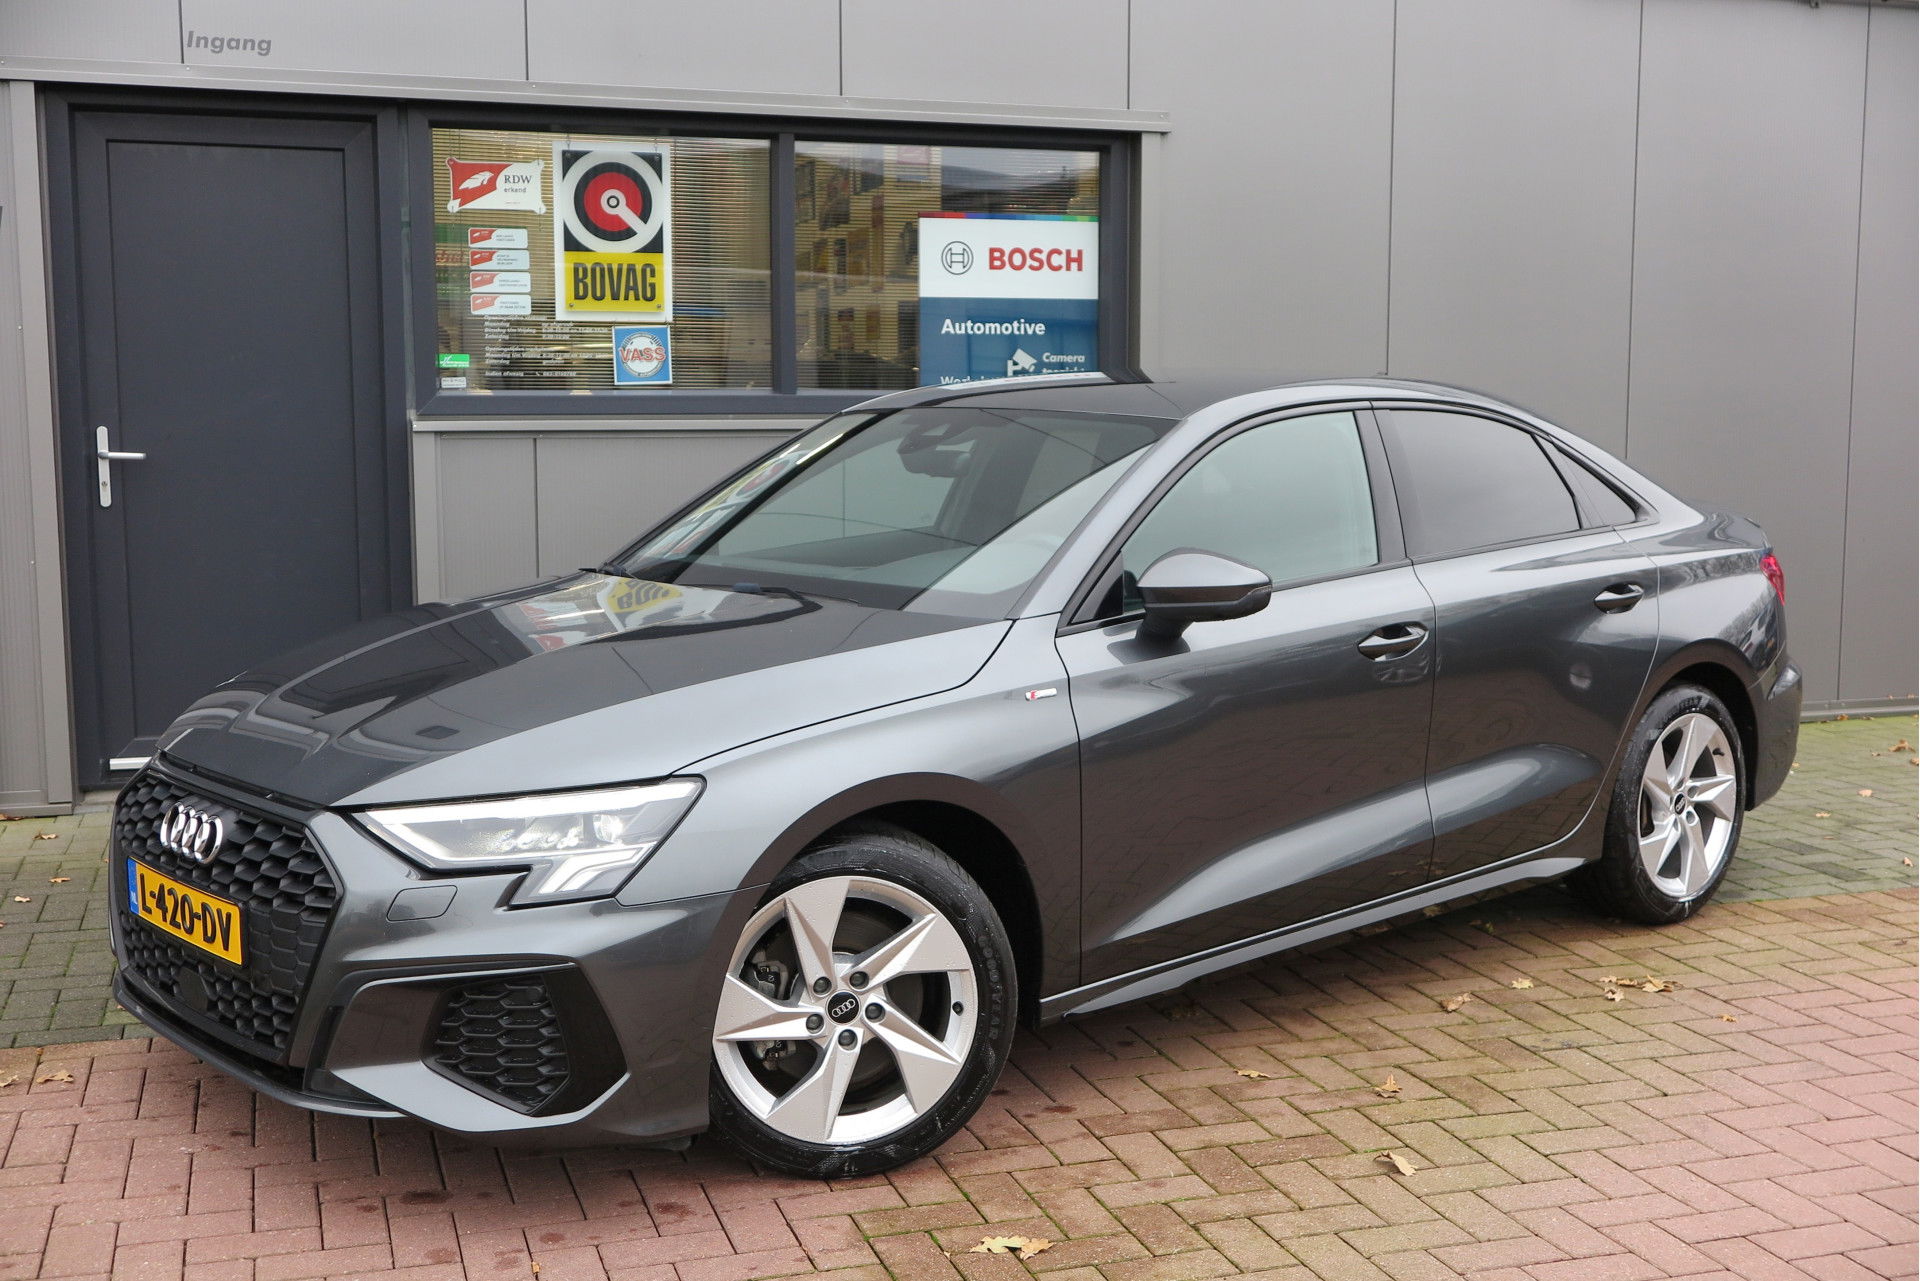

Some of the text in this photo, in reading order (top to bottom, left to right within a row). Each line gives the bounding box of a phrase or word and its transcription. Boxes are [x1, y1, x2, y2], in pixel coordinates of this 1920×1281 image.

[187, 30, 272, 56] Ingang
[504, 174, 532, 184] RDW
[988, 247, 1084, 272] BOSCH
[573, 261, 656, 302] BOVAG
[940, 318, 1046, 335] Automotive
[618, 346, 667, 362] VASS
[1042, 352, 1085, 363] Camera
[140, 872, 232, 952] L-420-DV
